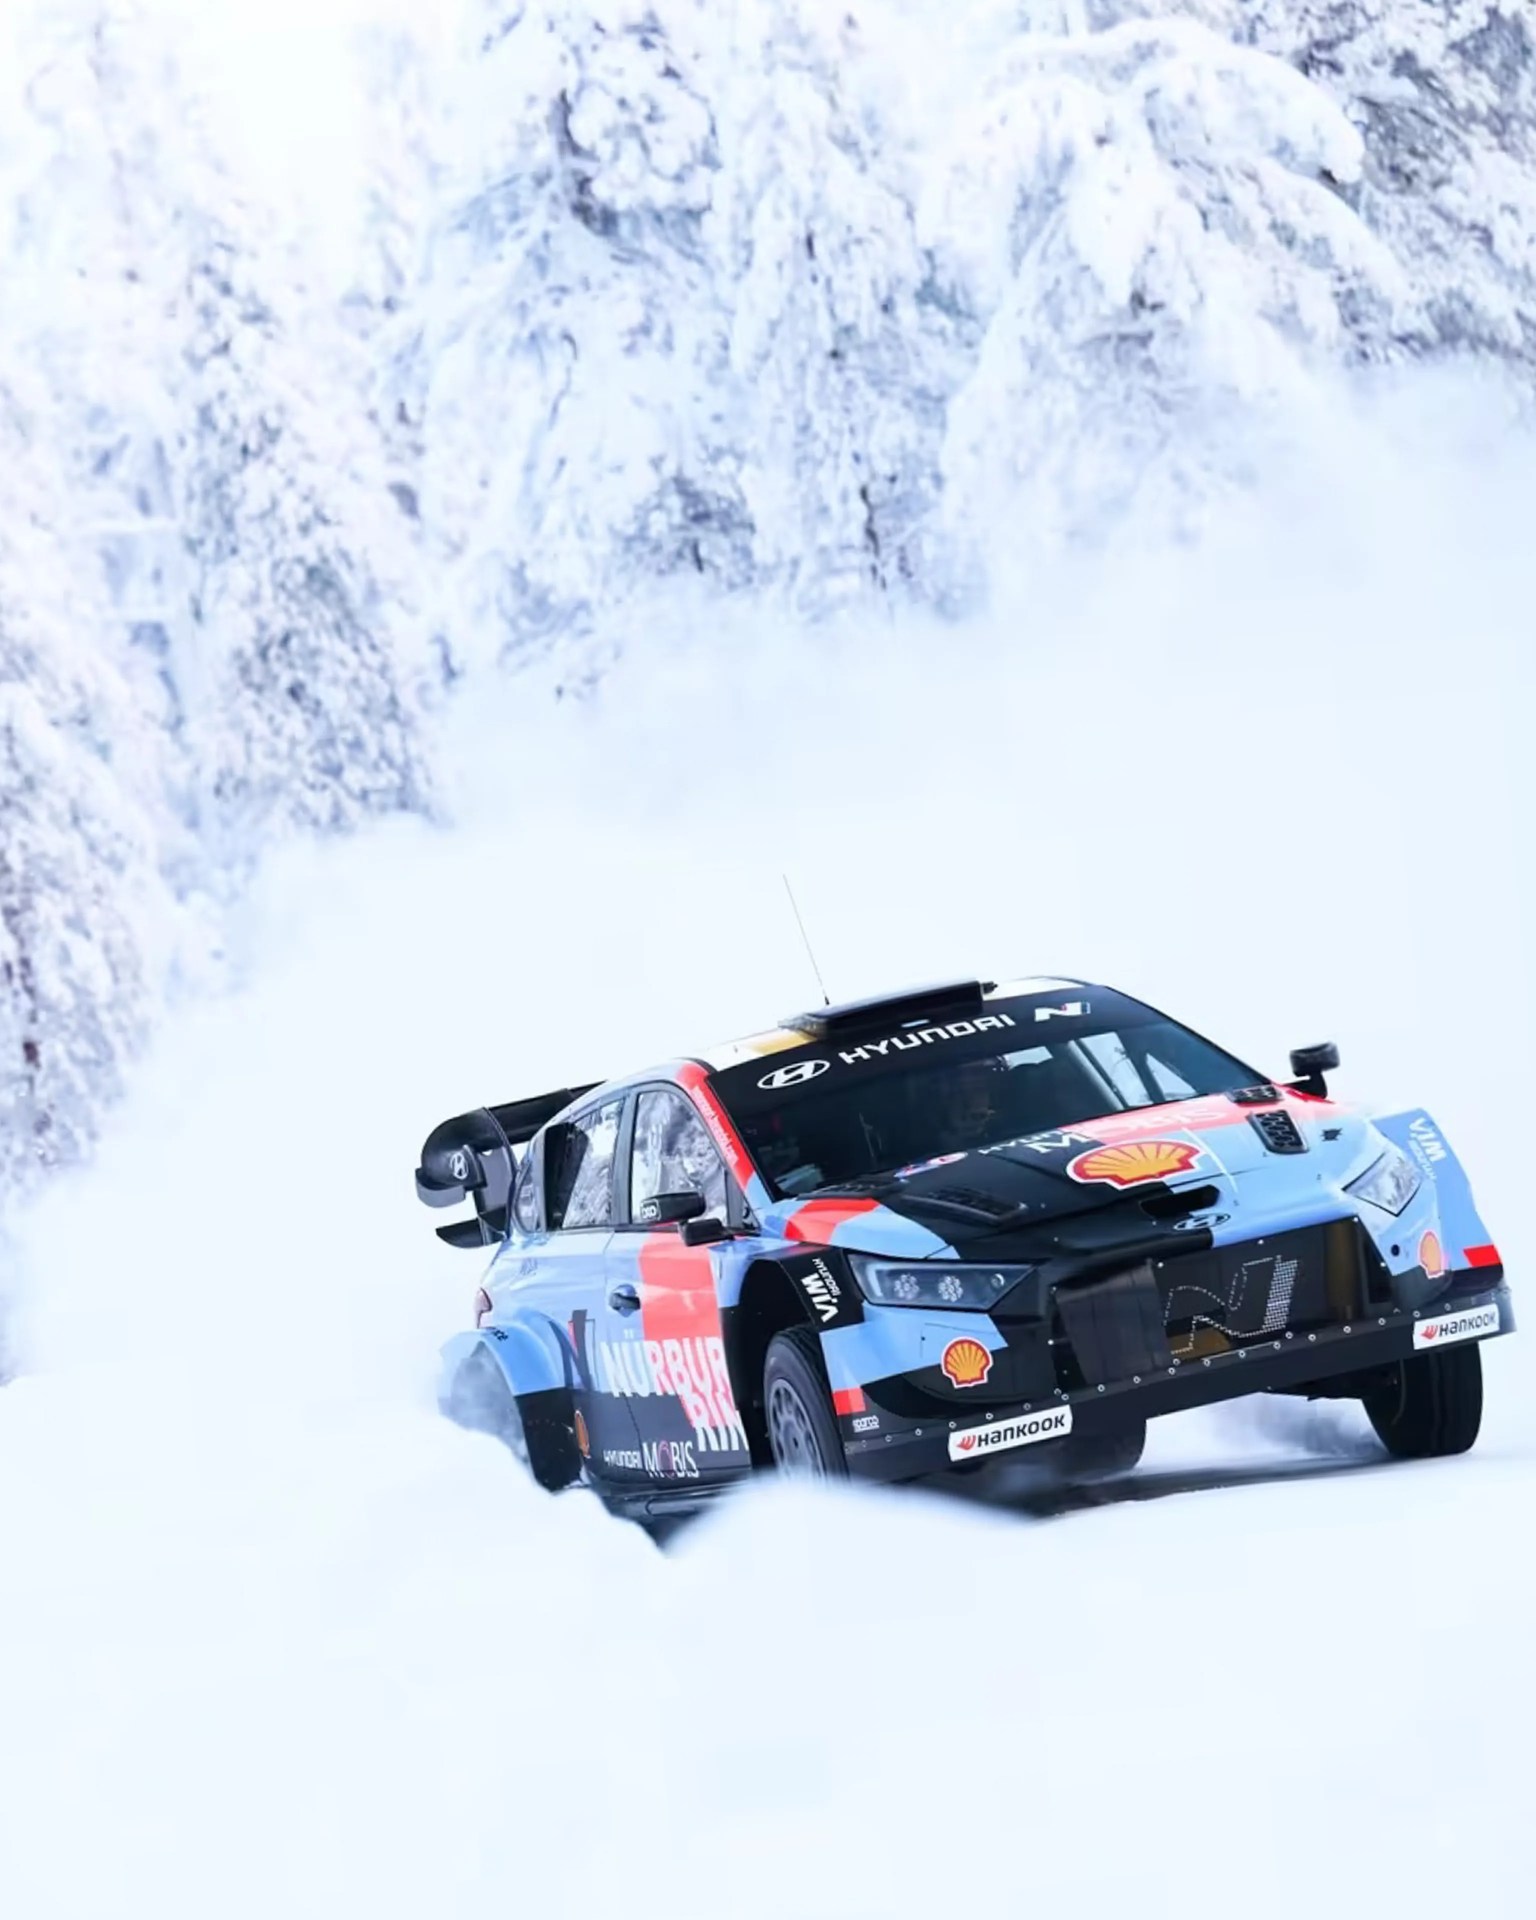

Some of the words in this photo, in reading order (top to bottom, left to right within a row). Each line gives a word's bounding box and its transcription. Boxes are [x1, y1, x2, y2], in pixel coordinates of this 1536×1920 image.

[838, 1013, 1016, 1065] HYUNDAI
[812, 1258, 841, 1296] HYUNDAI
[642, 1440, 700, 1480] MOBIS
